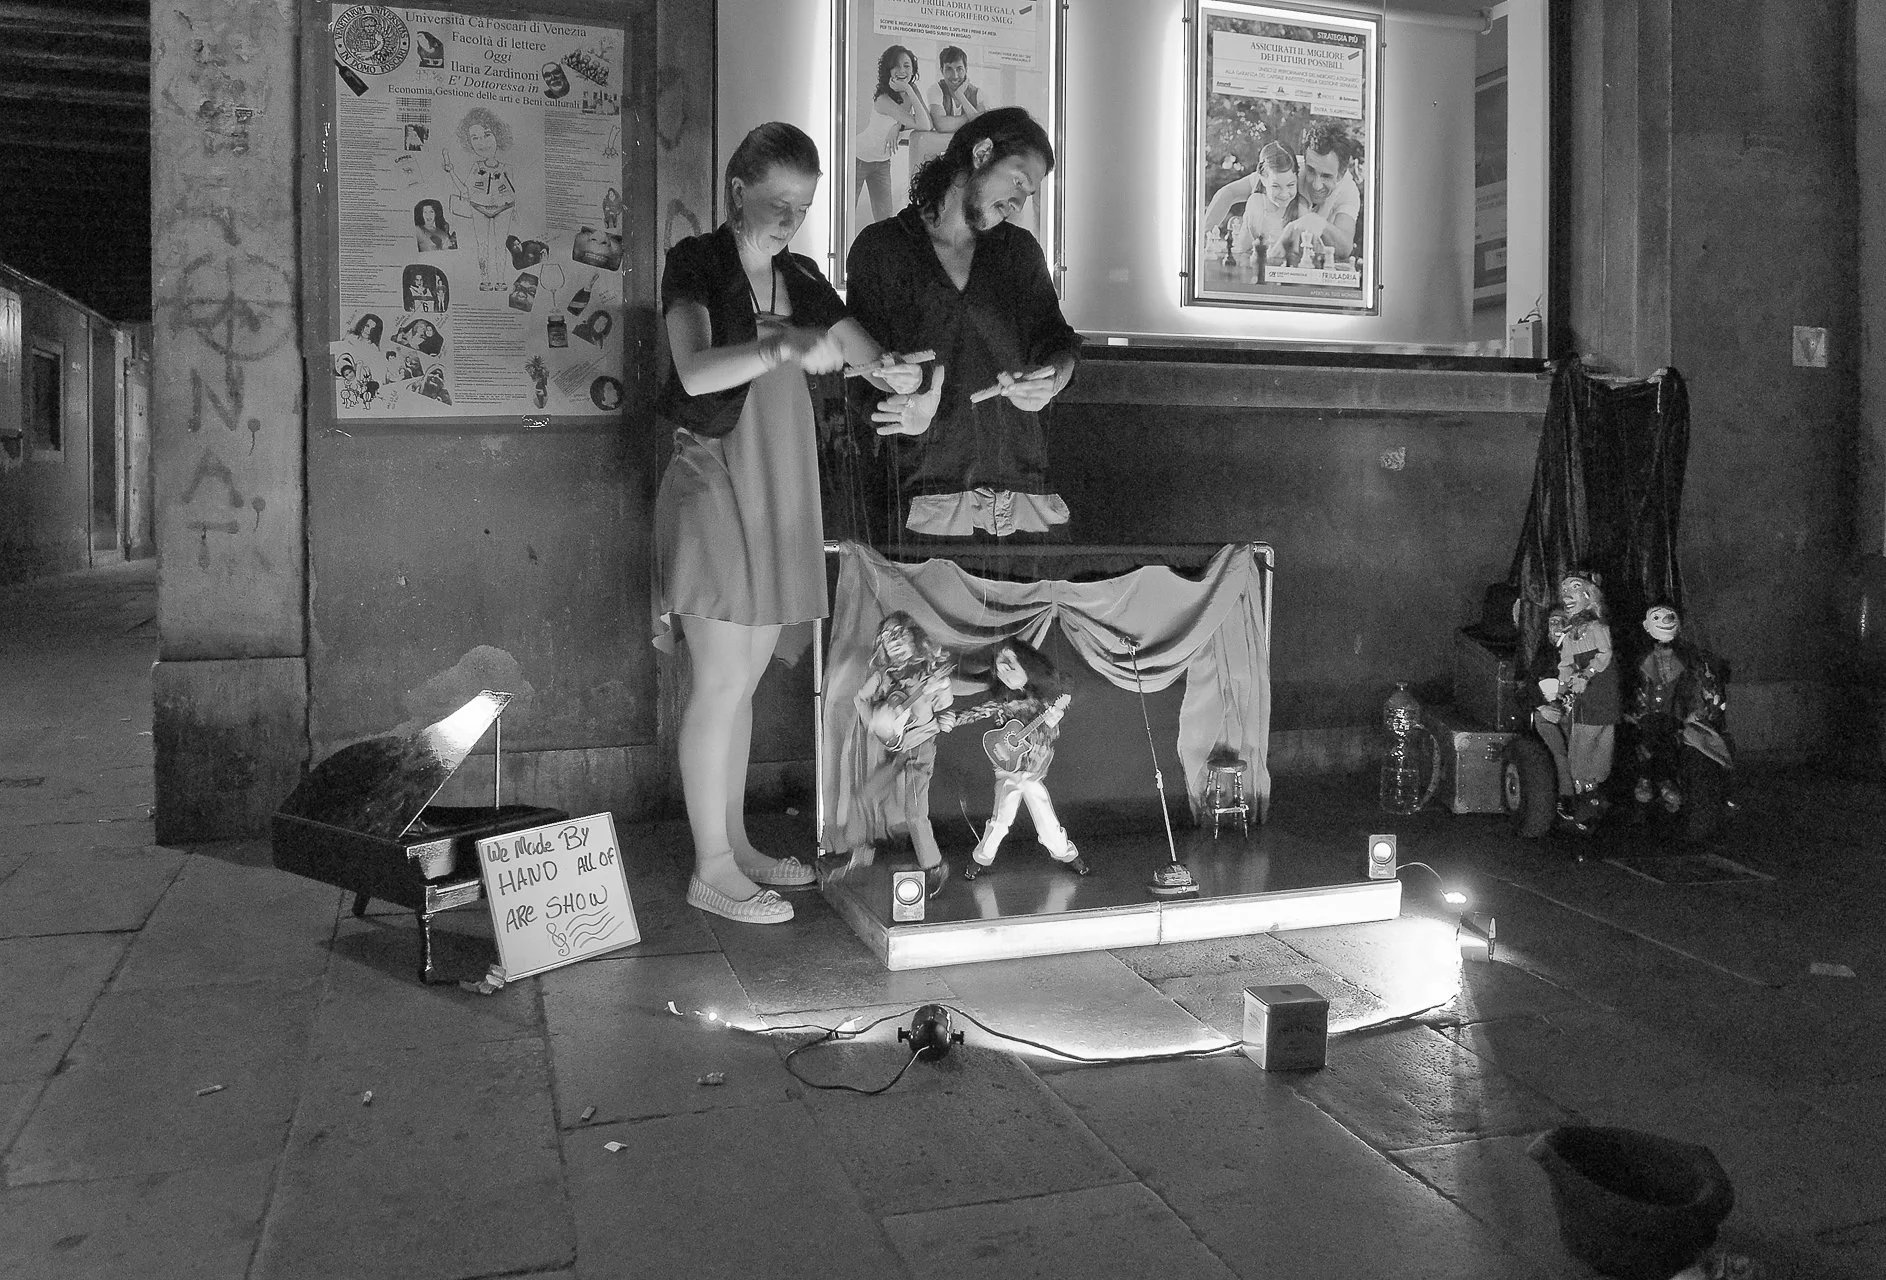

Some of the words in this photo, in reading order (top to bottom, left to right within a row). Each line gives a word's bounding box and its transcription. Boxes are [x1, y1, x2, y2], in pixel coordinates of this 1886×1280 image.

[921, 0, 972, 10] FRIULADRIA
[984, 5, 1015, 15] REGALA
[935, 9, 990, 21] FRIGORIFERO
[405, 11, 465, 26] Università
[486, 18, 527, 32] Foscari
[530, 22, 540, 33] di
[543, 23, 587, 37] Venezia
[451, 32, 494, 47] Facoltà
[497, 37, 508, 48] di
[512, 39, 547, 52] lettere
[1317, 32, 1347, 42] STRATEGIA
[352, 59, 376, 74] DOMO
[380, 48, 407, 73] FOSCARI
[484, 49, 513, 64] Oggi
[1250, 41, 1297, 54] ASSICURATI
[1307, 49, 1345, 61] MIGLIORE
[1260, 52, 1275, 62] DEI
[1275, 54, 1307, 65] FUTURI
[450, 61, 481, 75] Ilaria
[484, 65, 540, 81] Zardinoni
[464, 76, 526, 93] Dottoressa
[528, 83, 540, 93] in
[476, 90, 497, 101] delle
[499, 94, 513, 104] arti
[523, 97, 543, 106] Beni
[545, 99, 580, 109] culturali
[486, 841, 511, 863] We
[515, 833, 555, 859] Made
[498, 860, 558, 896] HAND
[545, 885, 608, 919] SHOW
